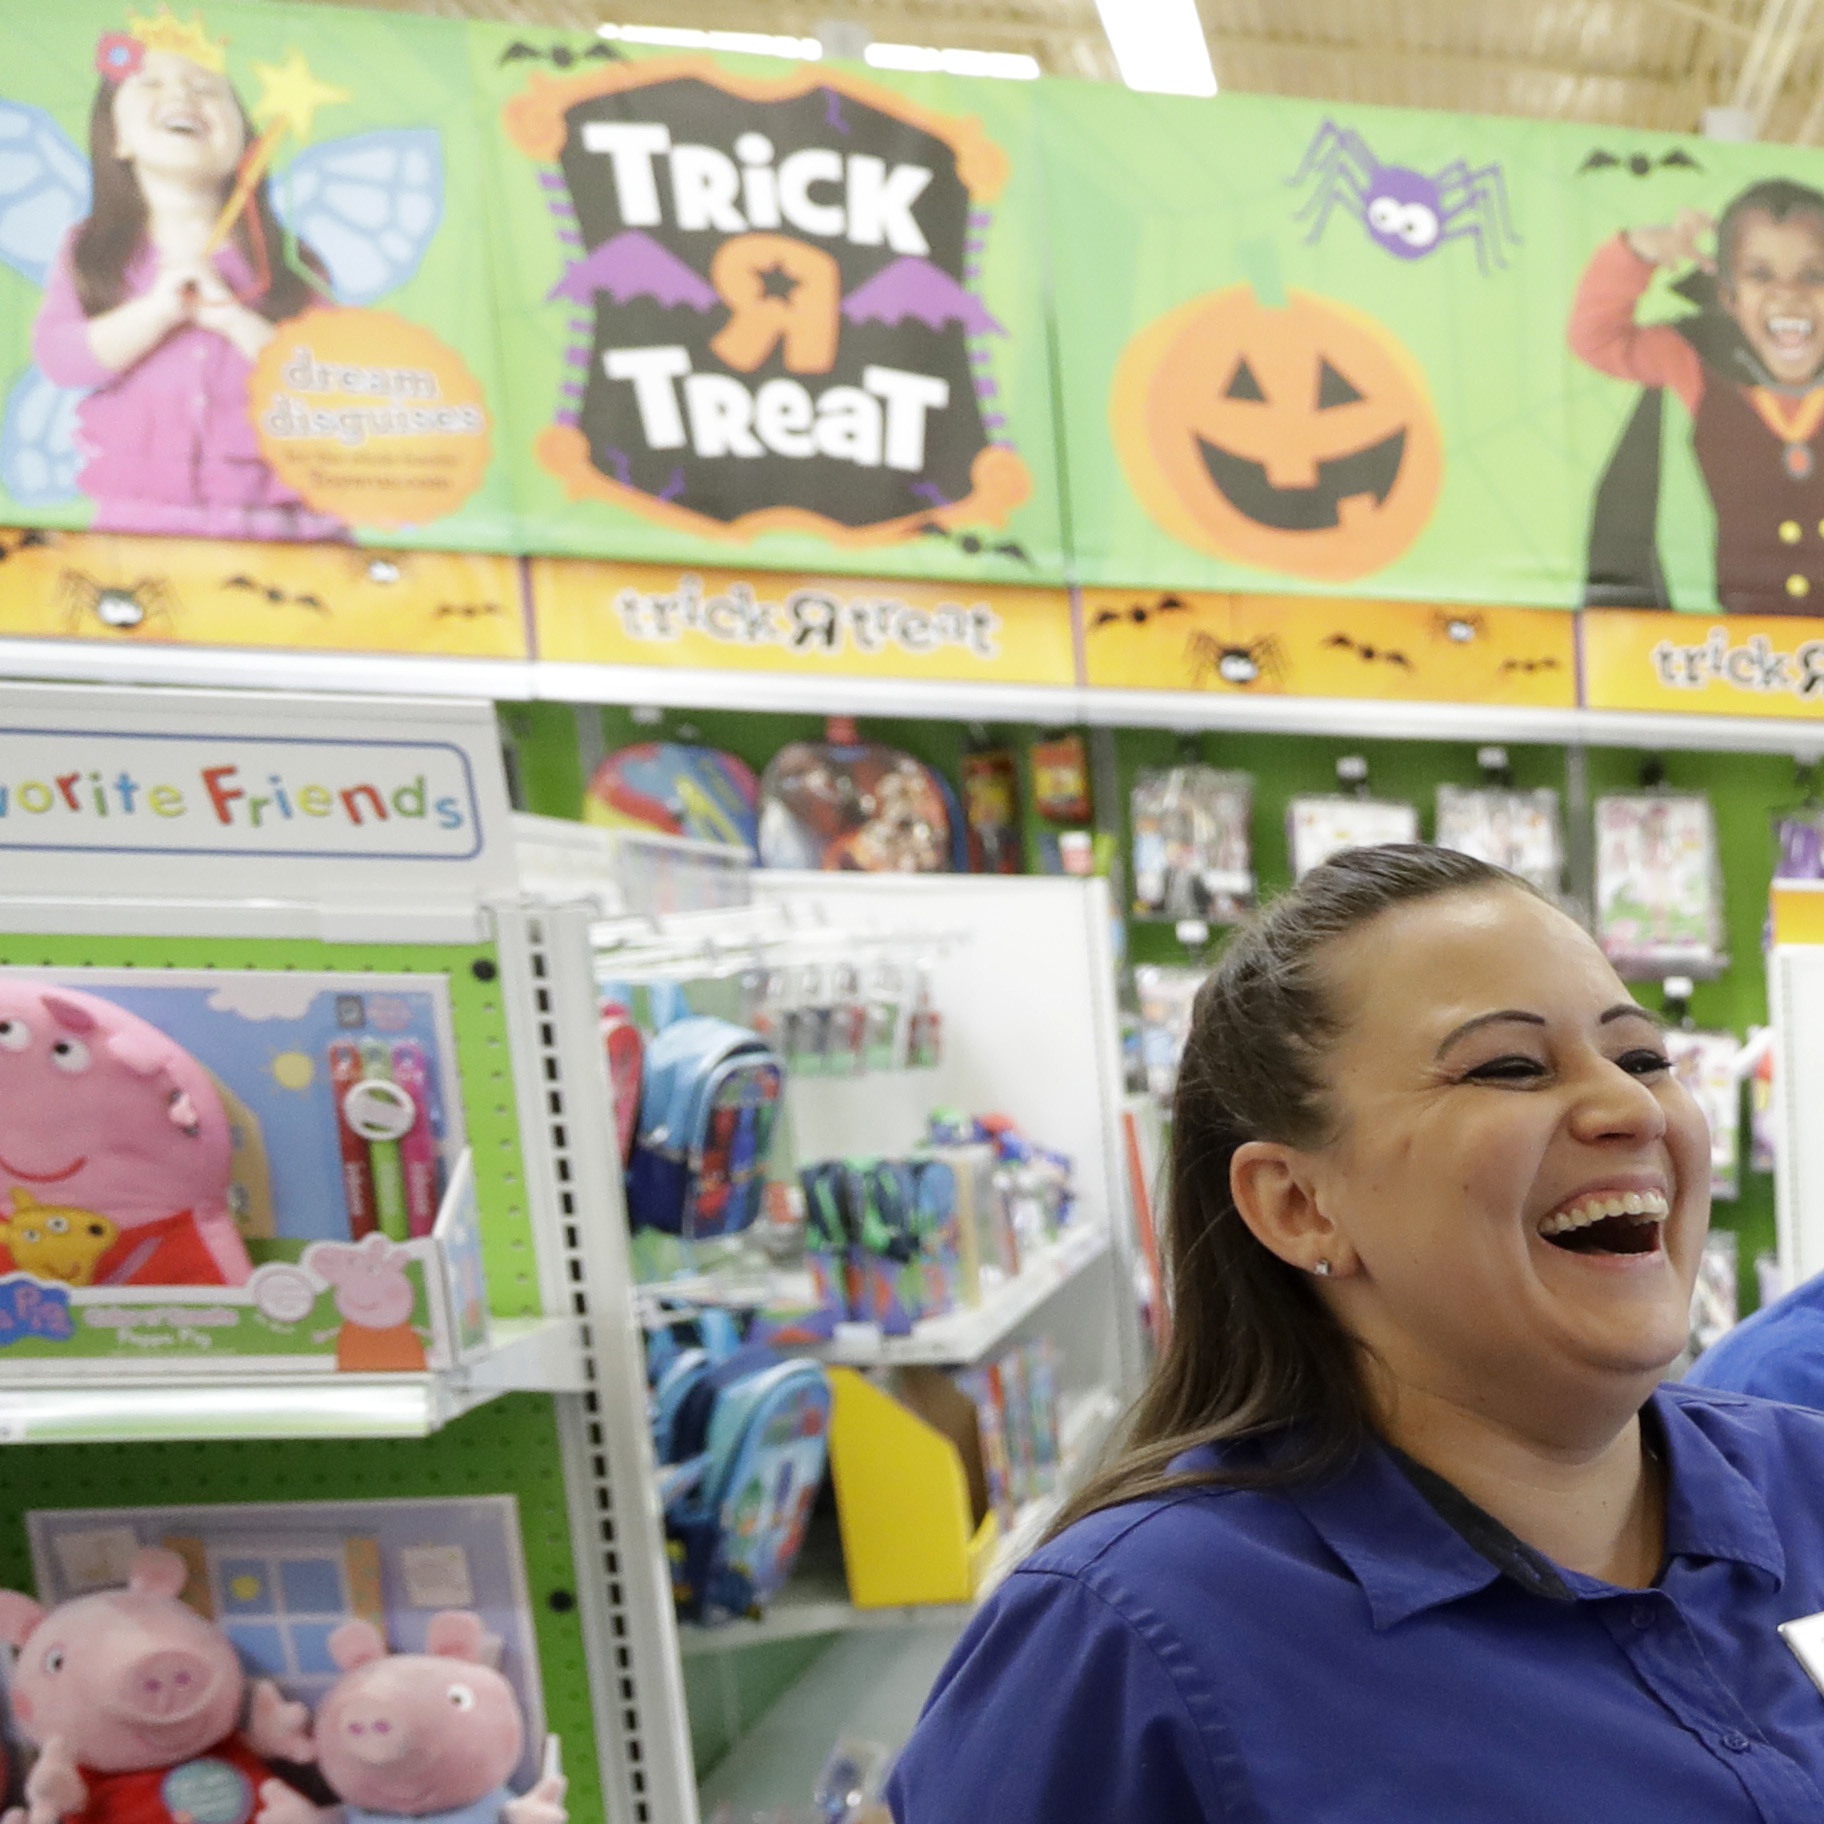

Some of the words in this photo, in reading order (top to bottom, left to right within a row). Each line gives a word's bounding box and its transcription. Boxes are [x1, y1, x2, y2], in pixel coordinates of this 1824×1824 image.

[284, 346, 440, 399] dream
[263, 393, 484, 445] disguises
[201, 764, 465, 831] Friends
